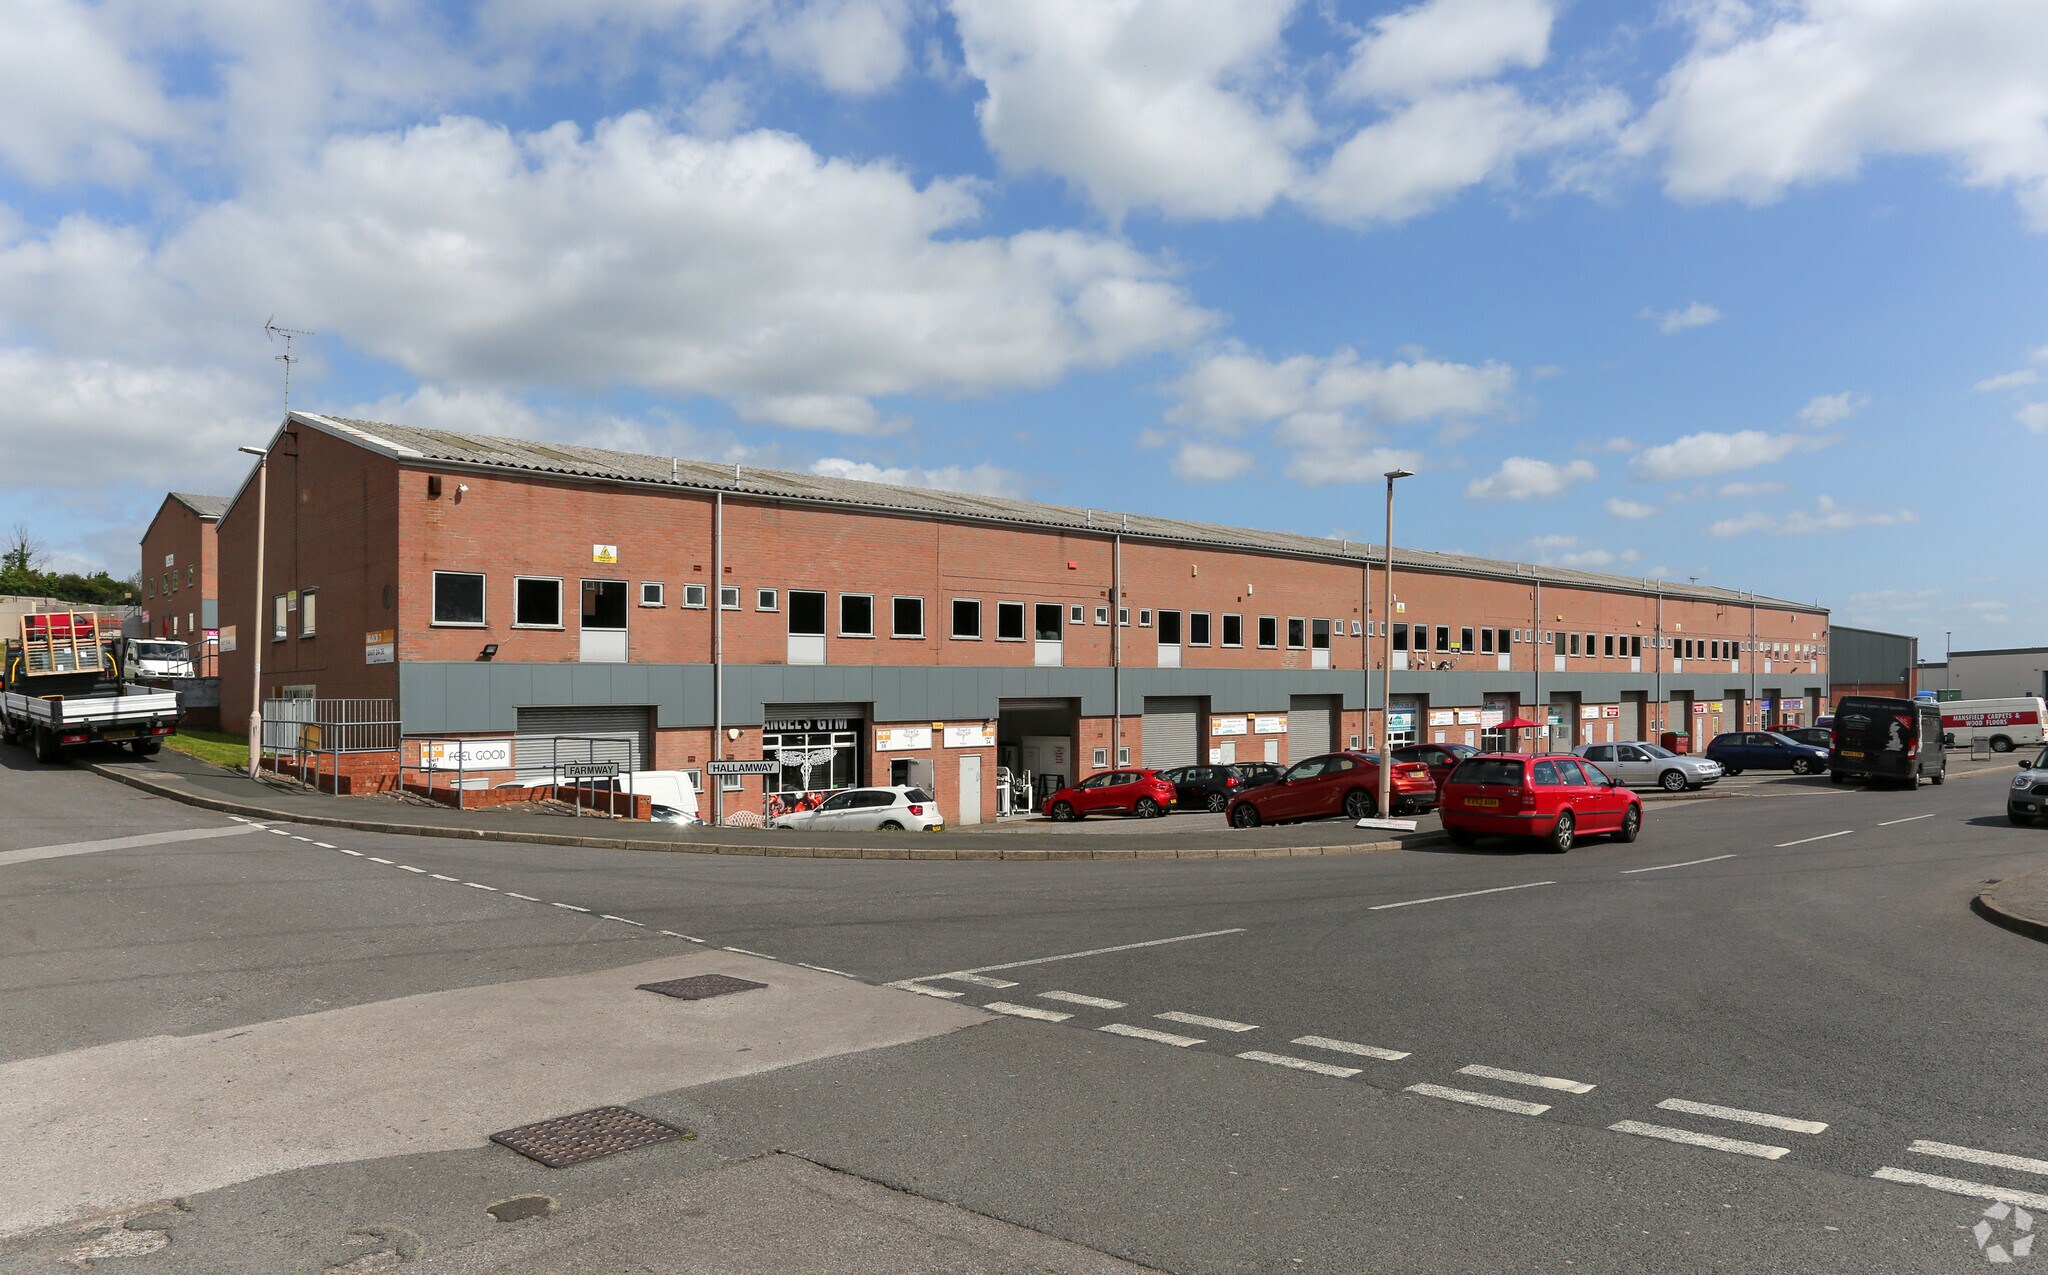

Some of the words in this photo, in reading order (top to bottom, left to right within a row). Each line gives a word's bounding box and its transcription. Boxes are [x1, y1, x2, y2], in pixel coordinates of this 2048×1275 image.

[1952, 713, 1984, 721] MANSFIELD
[1987, 712, 2012, 720] CARPETS
[817, 718, 847, 731] GYM
[448, 751, 472, 761] FEEL
[475, 749, 506, 760] GOOD
[570, 766, 613, 775] FARMWAY
[712, 763, 773, 773] HALLAMWAY
